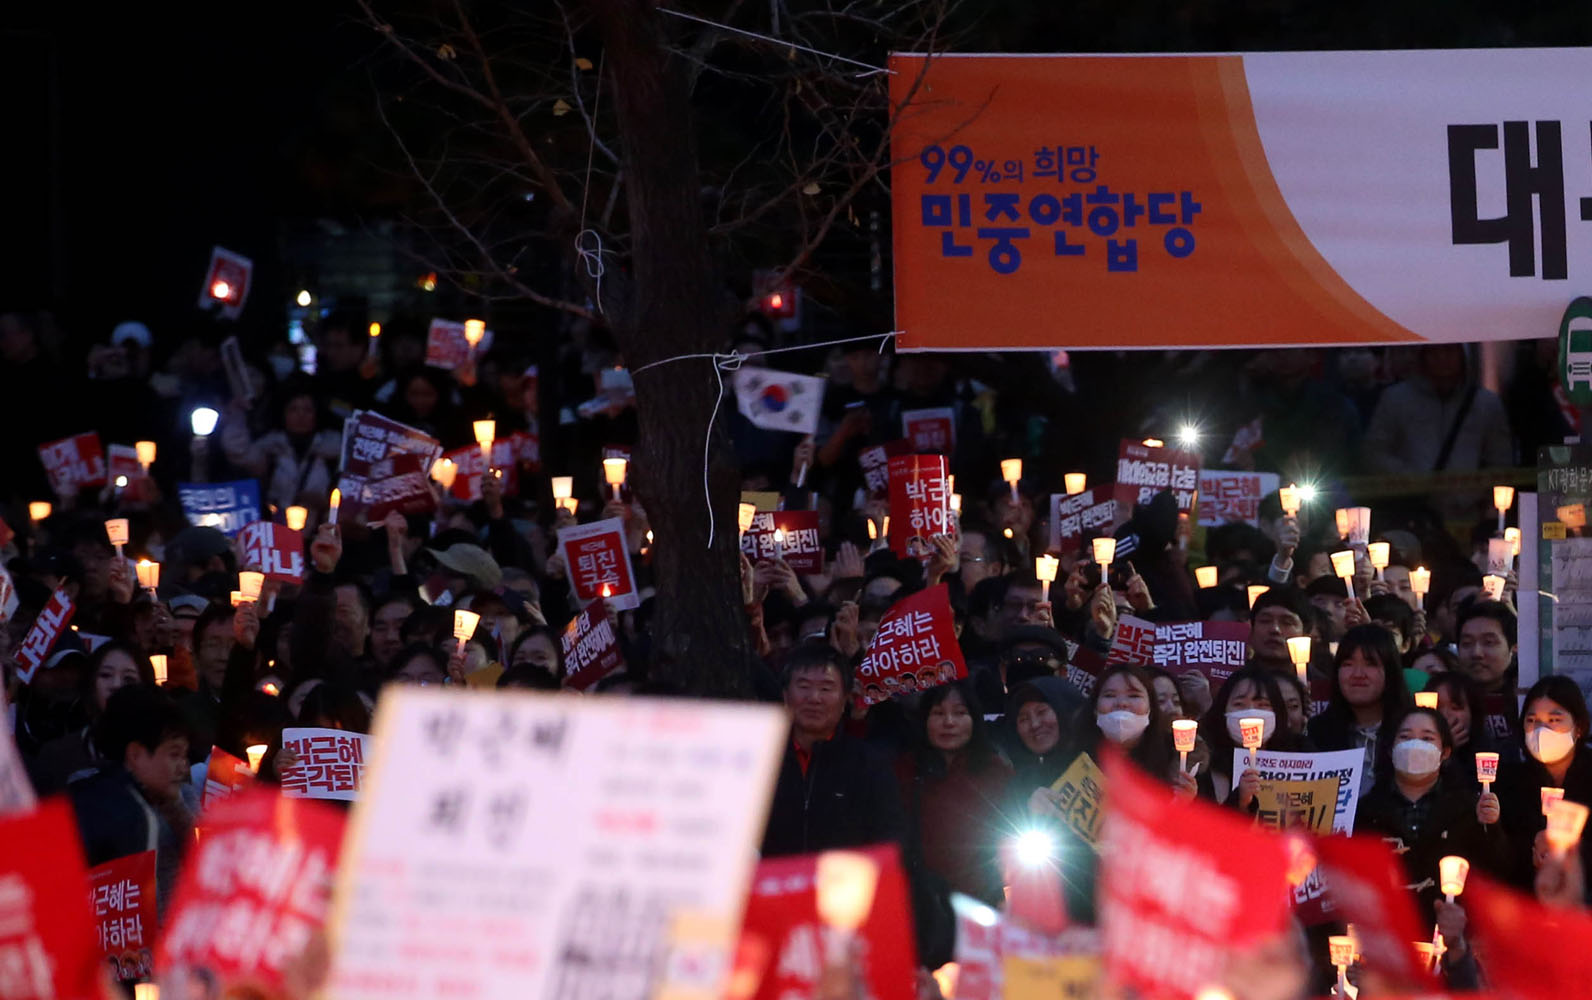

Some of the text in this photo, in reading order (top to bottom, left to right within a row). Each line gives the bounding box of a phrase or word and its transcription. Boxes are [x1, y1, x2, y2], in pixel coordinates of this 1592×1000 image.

[920, 144, 1100, 184] 99%의 희망
[920, 185, 1203, 274] 민중연합당
[577, 548, 618, 573] 퇴진
[1156, 621, 1204, 643] 박근혜
[860, 634, 941, 678] 하야하라
[1153, 640, 1247, 667] 즉각 완전퇴진!
[284, 736, 364, 766] 박근혜
[1242, 755, 1277, 769] 아것도
[281, 764, 362, 793] 즉각퇴
